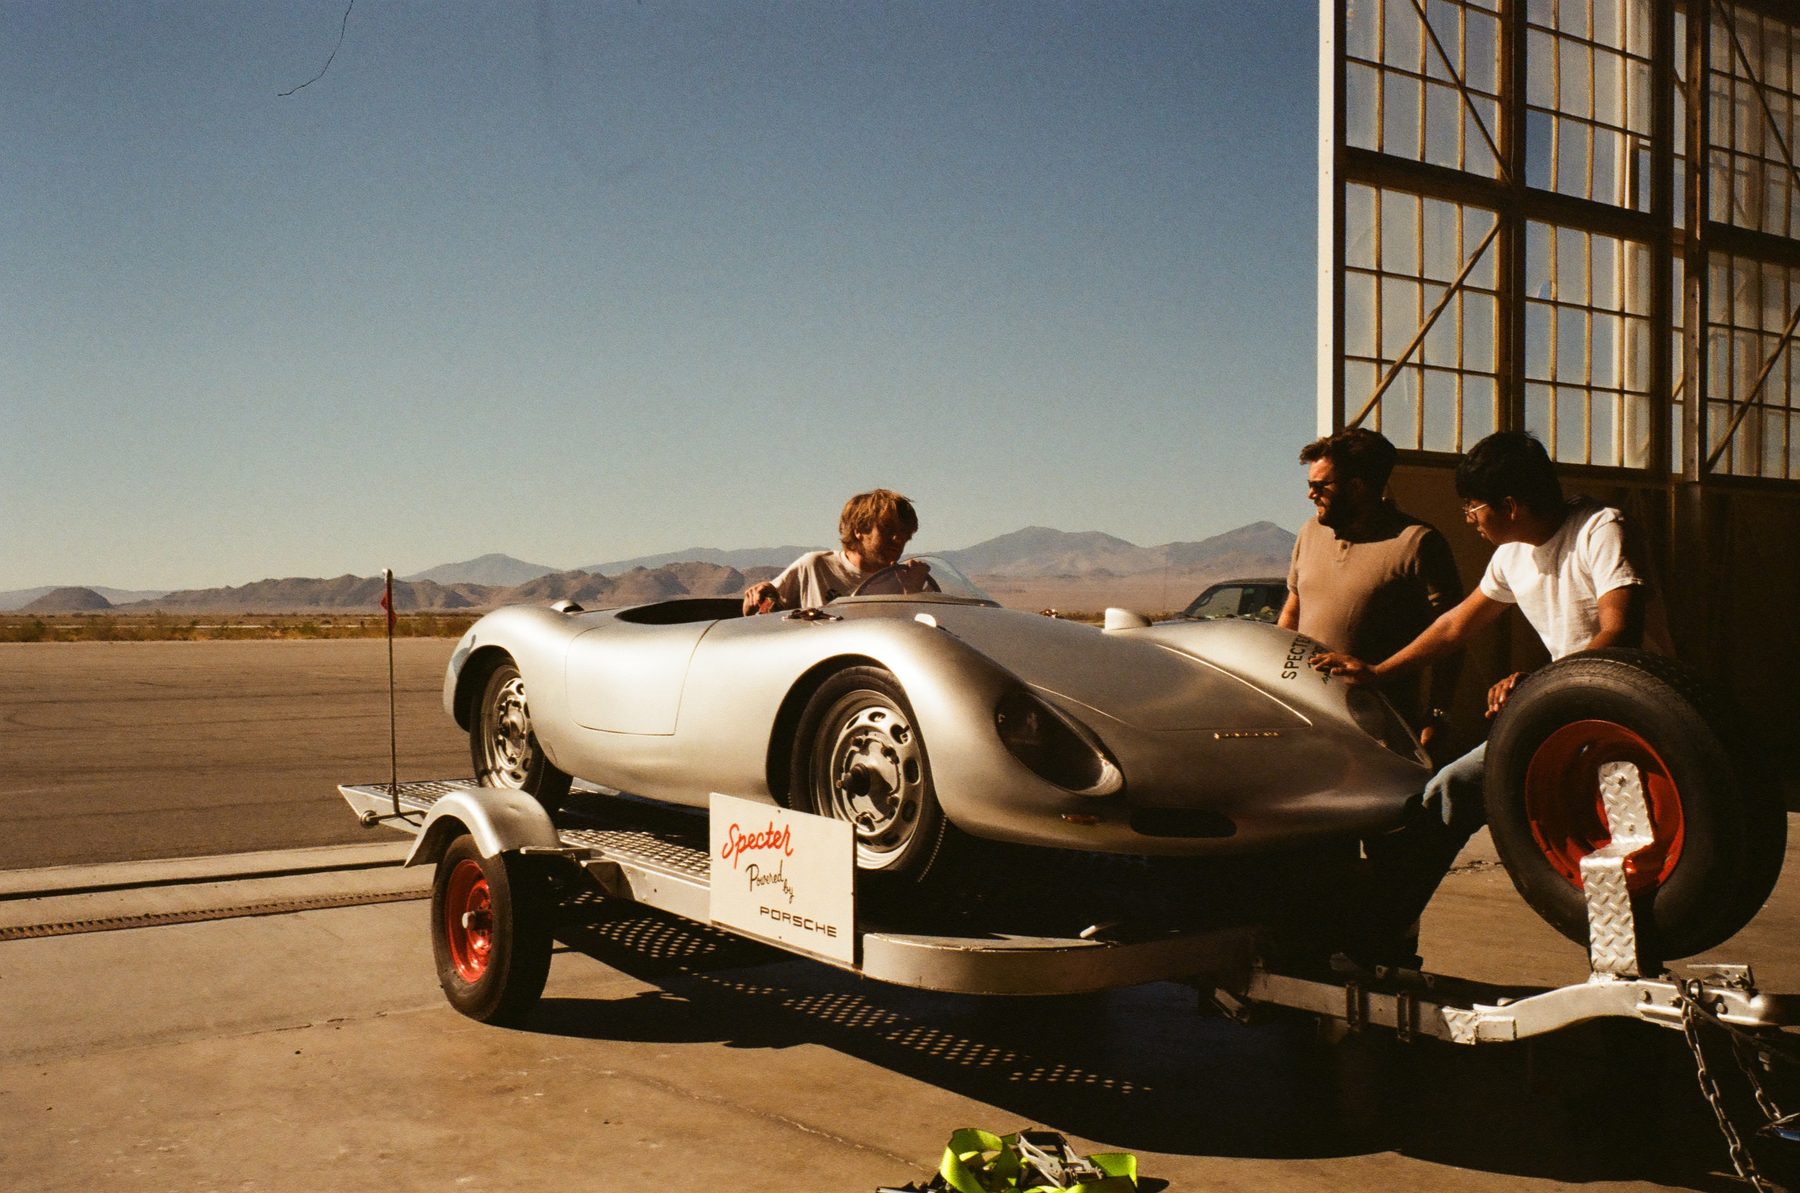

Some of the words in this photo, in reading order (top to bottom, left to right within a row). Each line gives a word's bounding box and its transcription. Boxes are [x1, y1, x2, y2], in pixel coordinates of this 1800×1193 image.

[721, 821, 794, 870] Specter
[745, 859, 784, 892] Powered
[782, 878, 795, 904] by
[759, 906, 837, 938] PORSCHE
